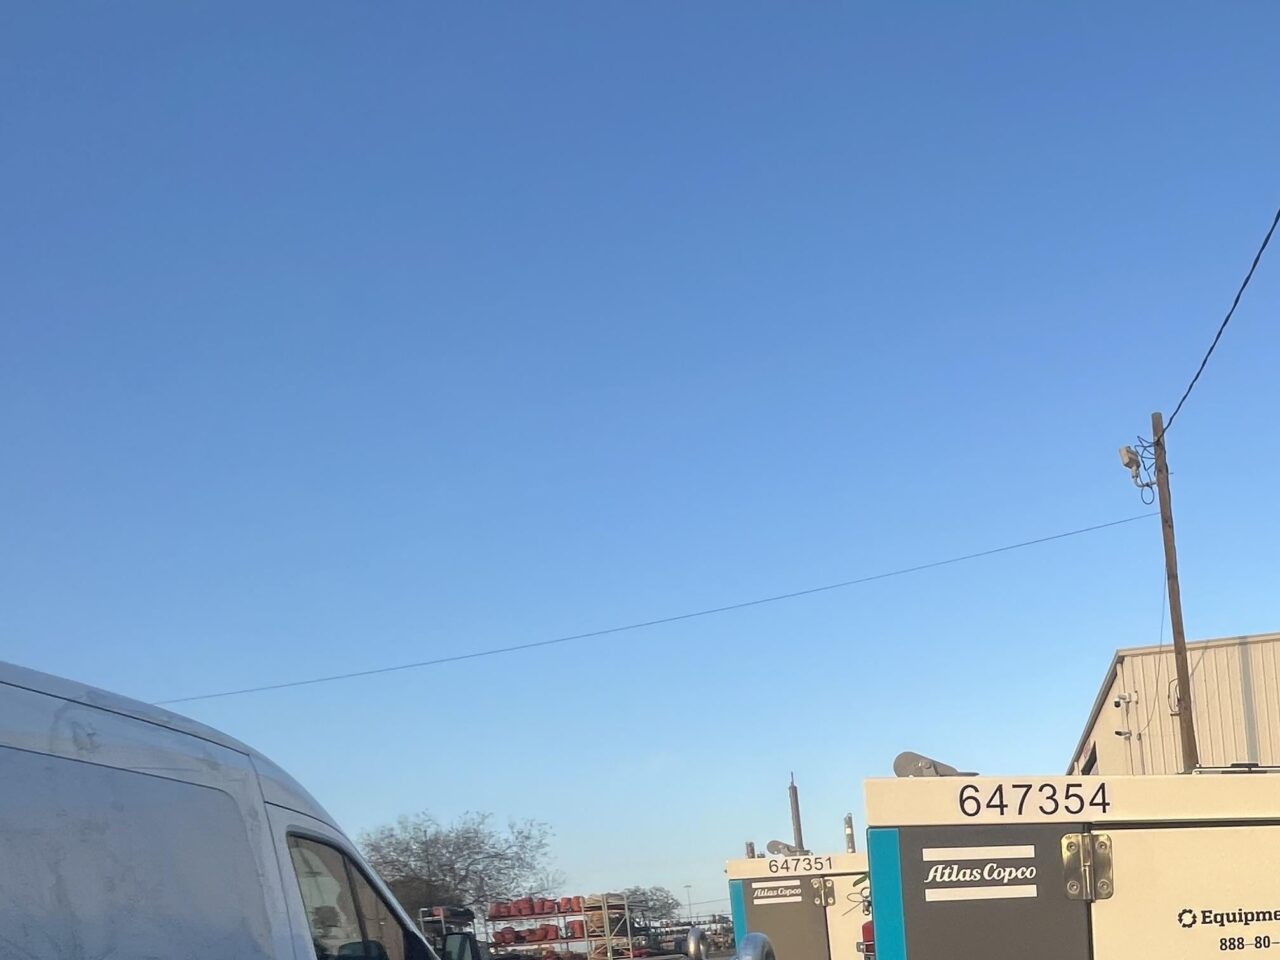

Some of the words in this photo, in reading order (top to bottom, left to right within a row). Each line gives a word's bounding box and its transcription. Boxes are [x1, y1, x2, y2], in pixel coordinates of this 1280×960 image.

[959, 782, 1111, 817] 647354
[769, 857, 832, 873] 647351
[924, 864, 981, 883] Atlas
[983, 863, 1037, 883] Copco
[753, 888, 777, 897] Atlas
[778, 888, 801, 896] Copco
